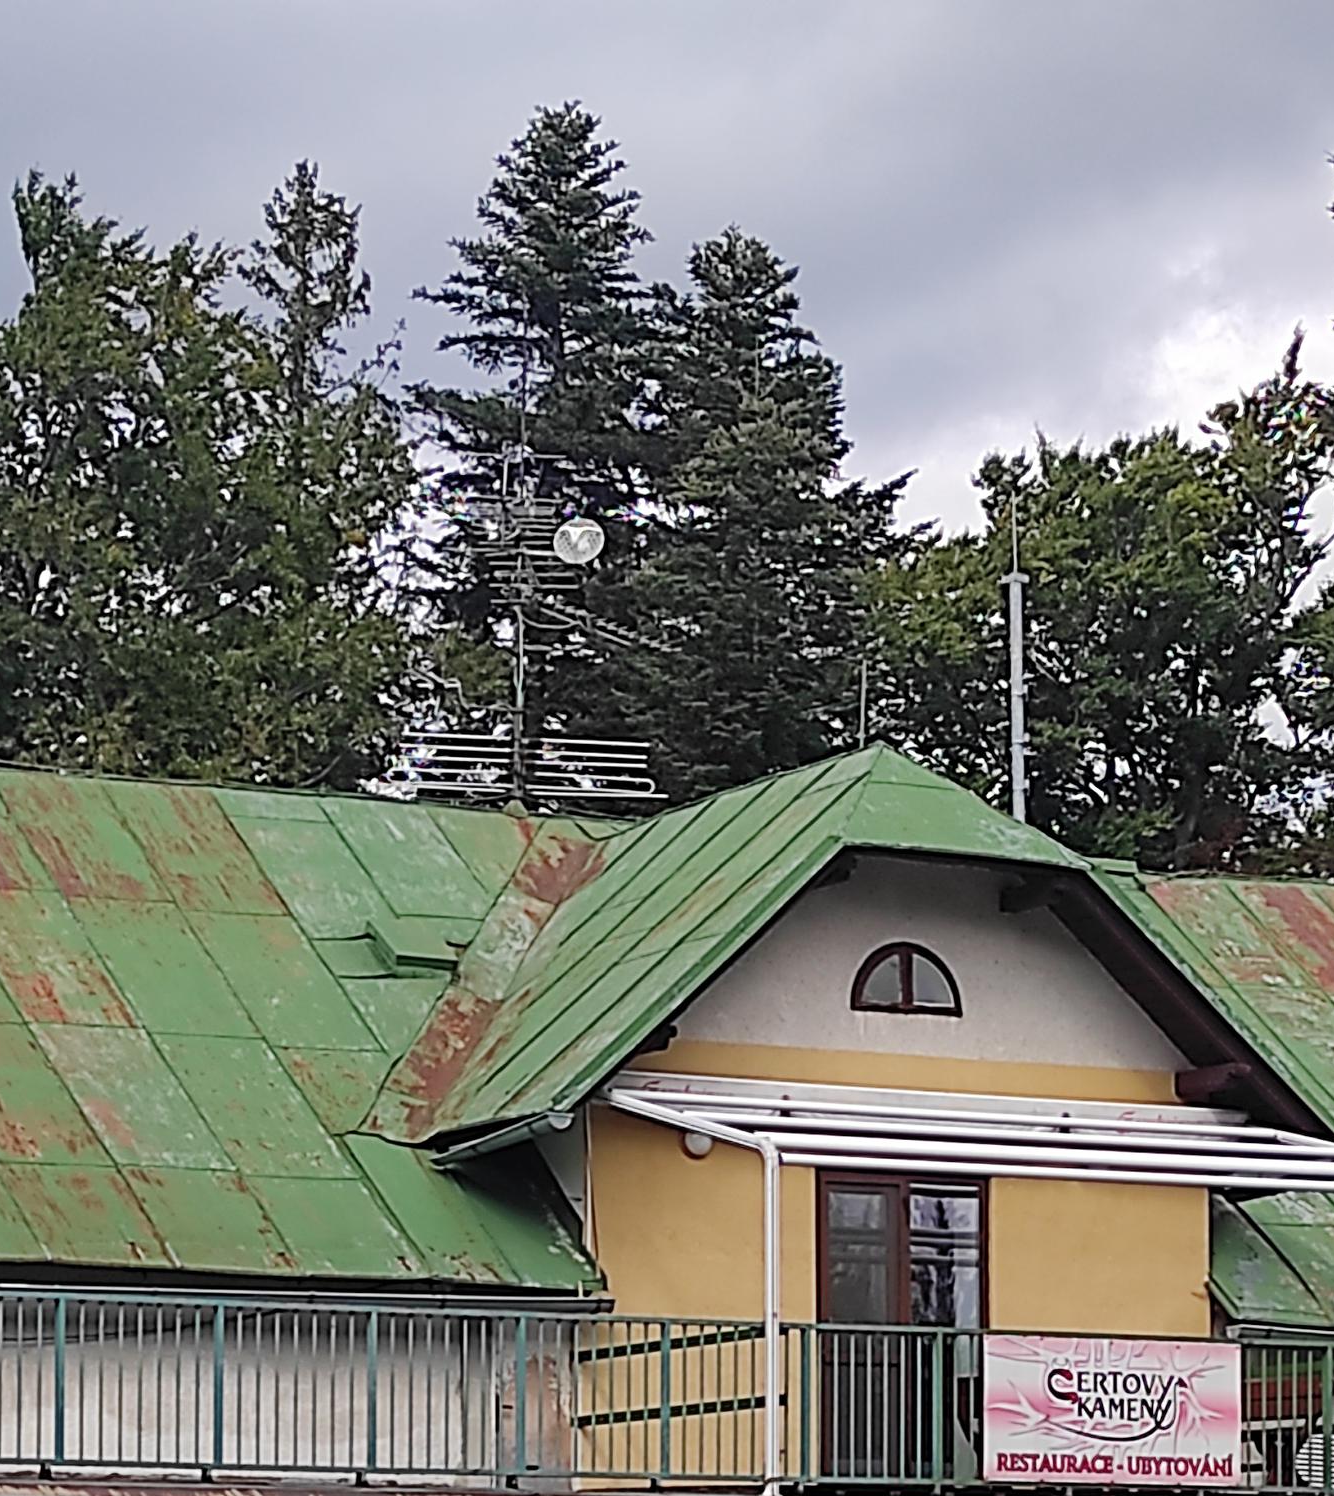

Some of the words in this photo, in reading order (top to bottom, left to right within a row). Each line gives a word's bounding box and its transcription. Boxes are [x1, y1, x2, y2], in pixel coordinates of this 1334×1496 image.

[1077, 1396, 1173, 1427] KAMENY
[996, 1453, 1114, 1474] RESTAURACE
[1126, 1453, 1234, 1477] UBYTOVÁNÍ
